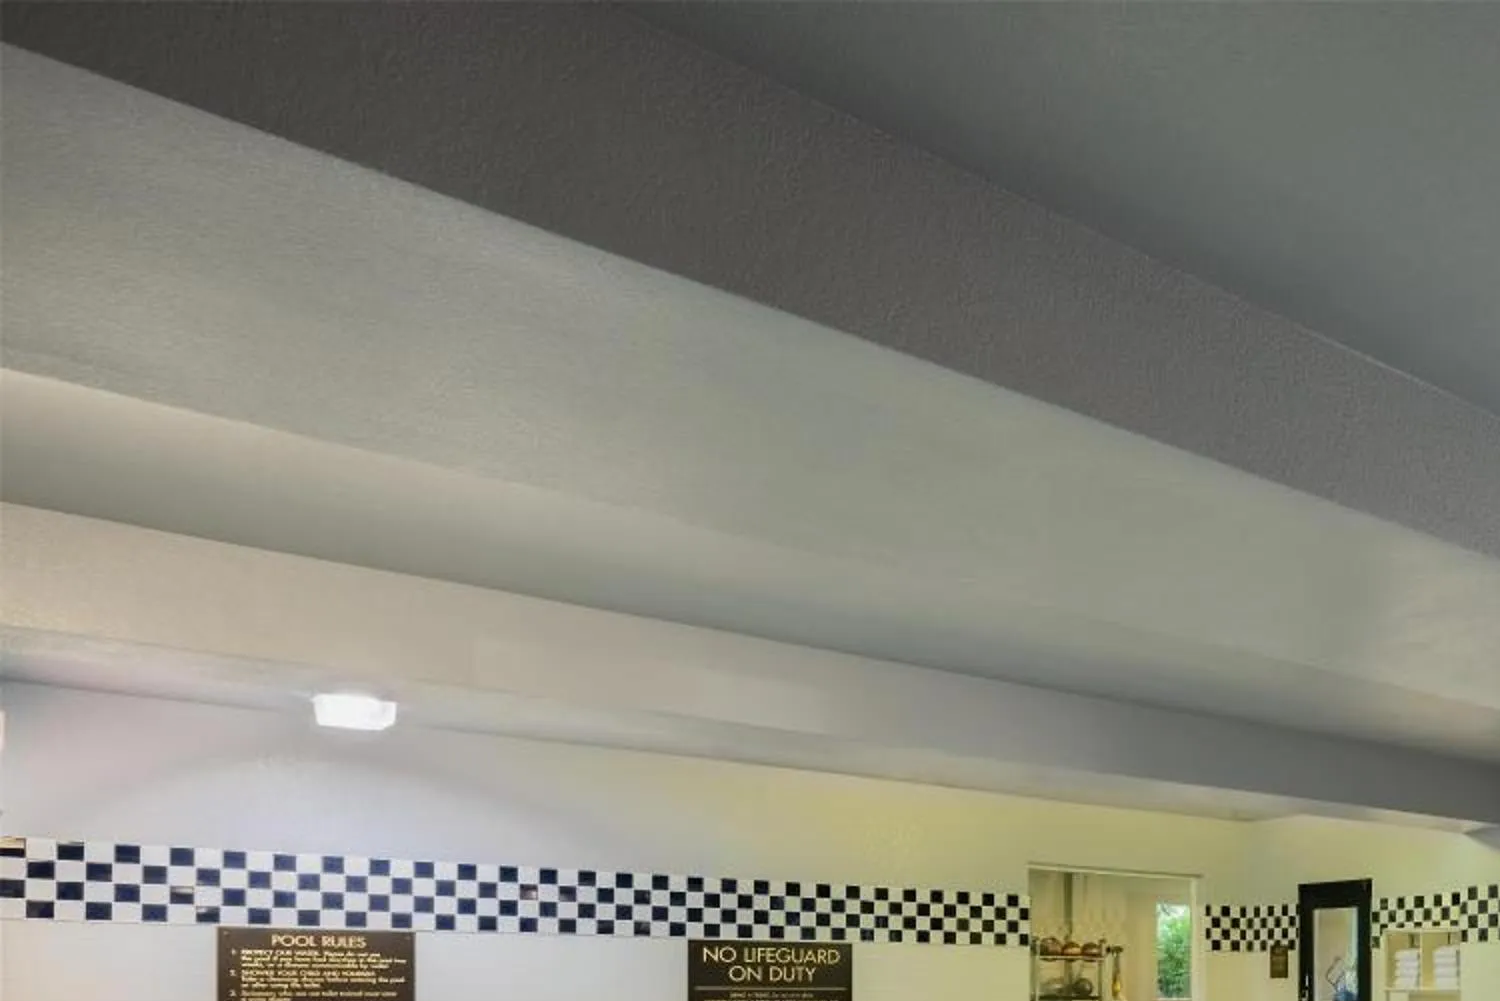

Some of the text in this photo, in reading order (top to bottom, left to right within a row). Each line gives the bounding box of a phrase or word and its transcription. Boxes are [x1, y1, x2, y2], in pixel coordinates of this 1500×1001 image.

[271, 934, 367, 949] POOL RULES
[703, 946, 840, 964] NO LIFEGUARD
[729, 965, 816, 982] ON DUTY
